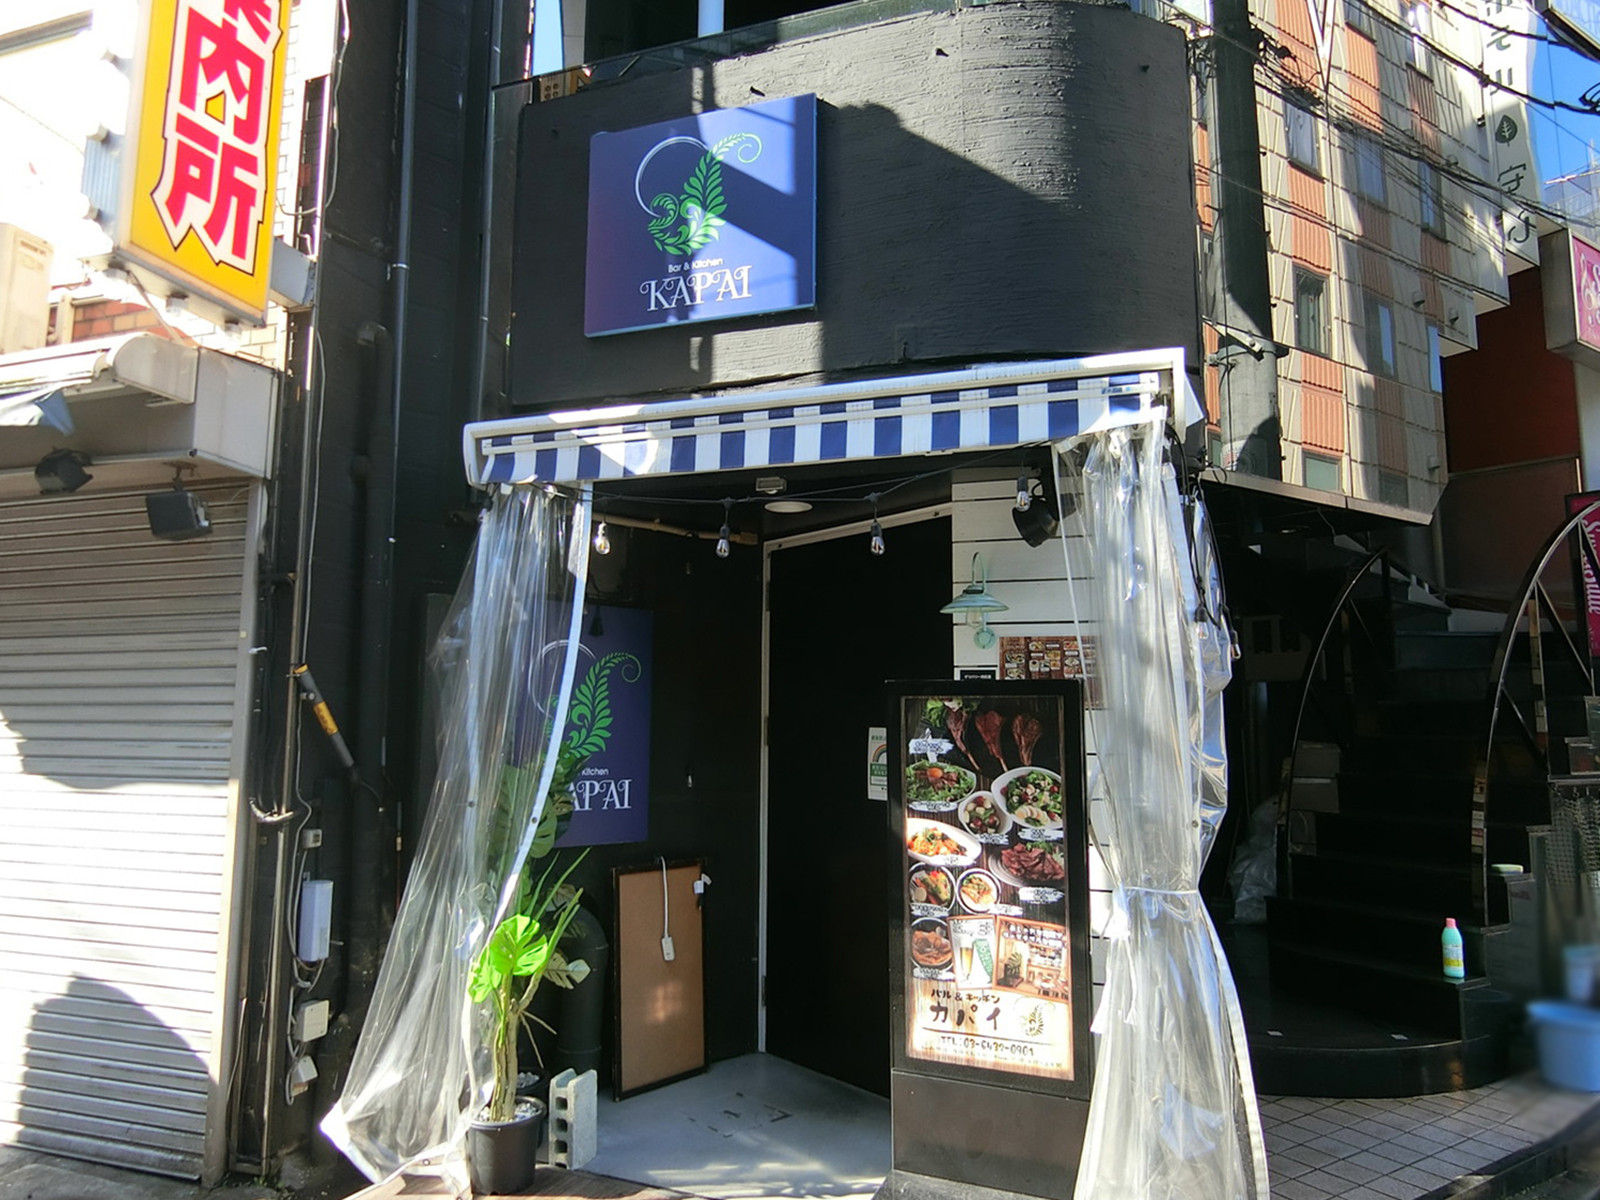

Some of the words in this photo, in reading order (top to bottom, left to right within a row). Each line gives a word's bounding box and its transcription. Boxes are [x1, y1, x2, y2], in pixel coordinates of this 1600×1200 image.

[165, 0, 272, 261] 肉所
[668, 264, 682, 273] Bar
[692, 258, 723, 270] Kitchen
[640, 265, 752, 311] KAPAI
[568, 779, 632, 811] APAI
[930, 1001, 1001, 1030] カパイ
